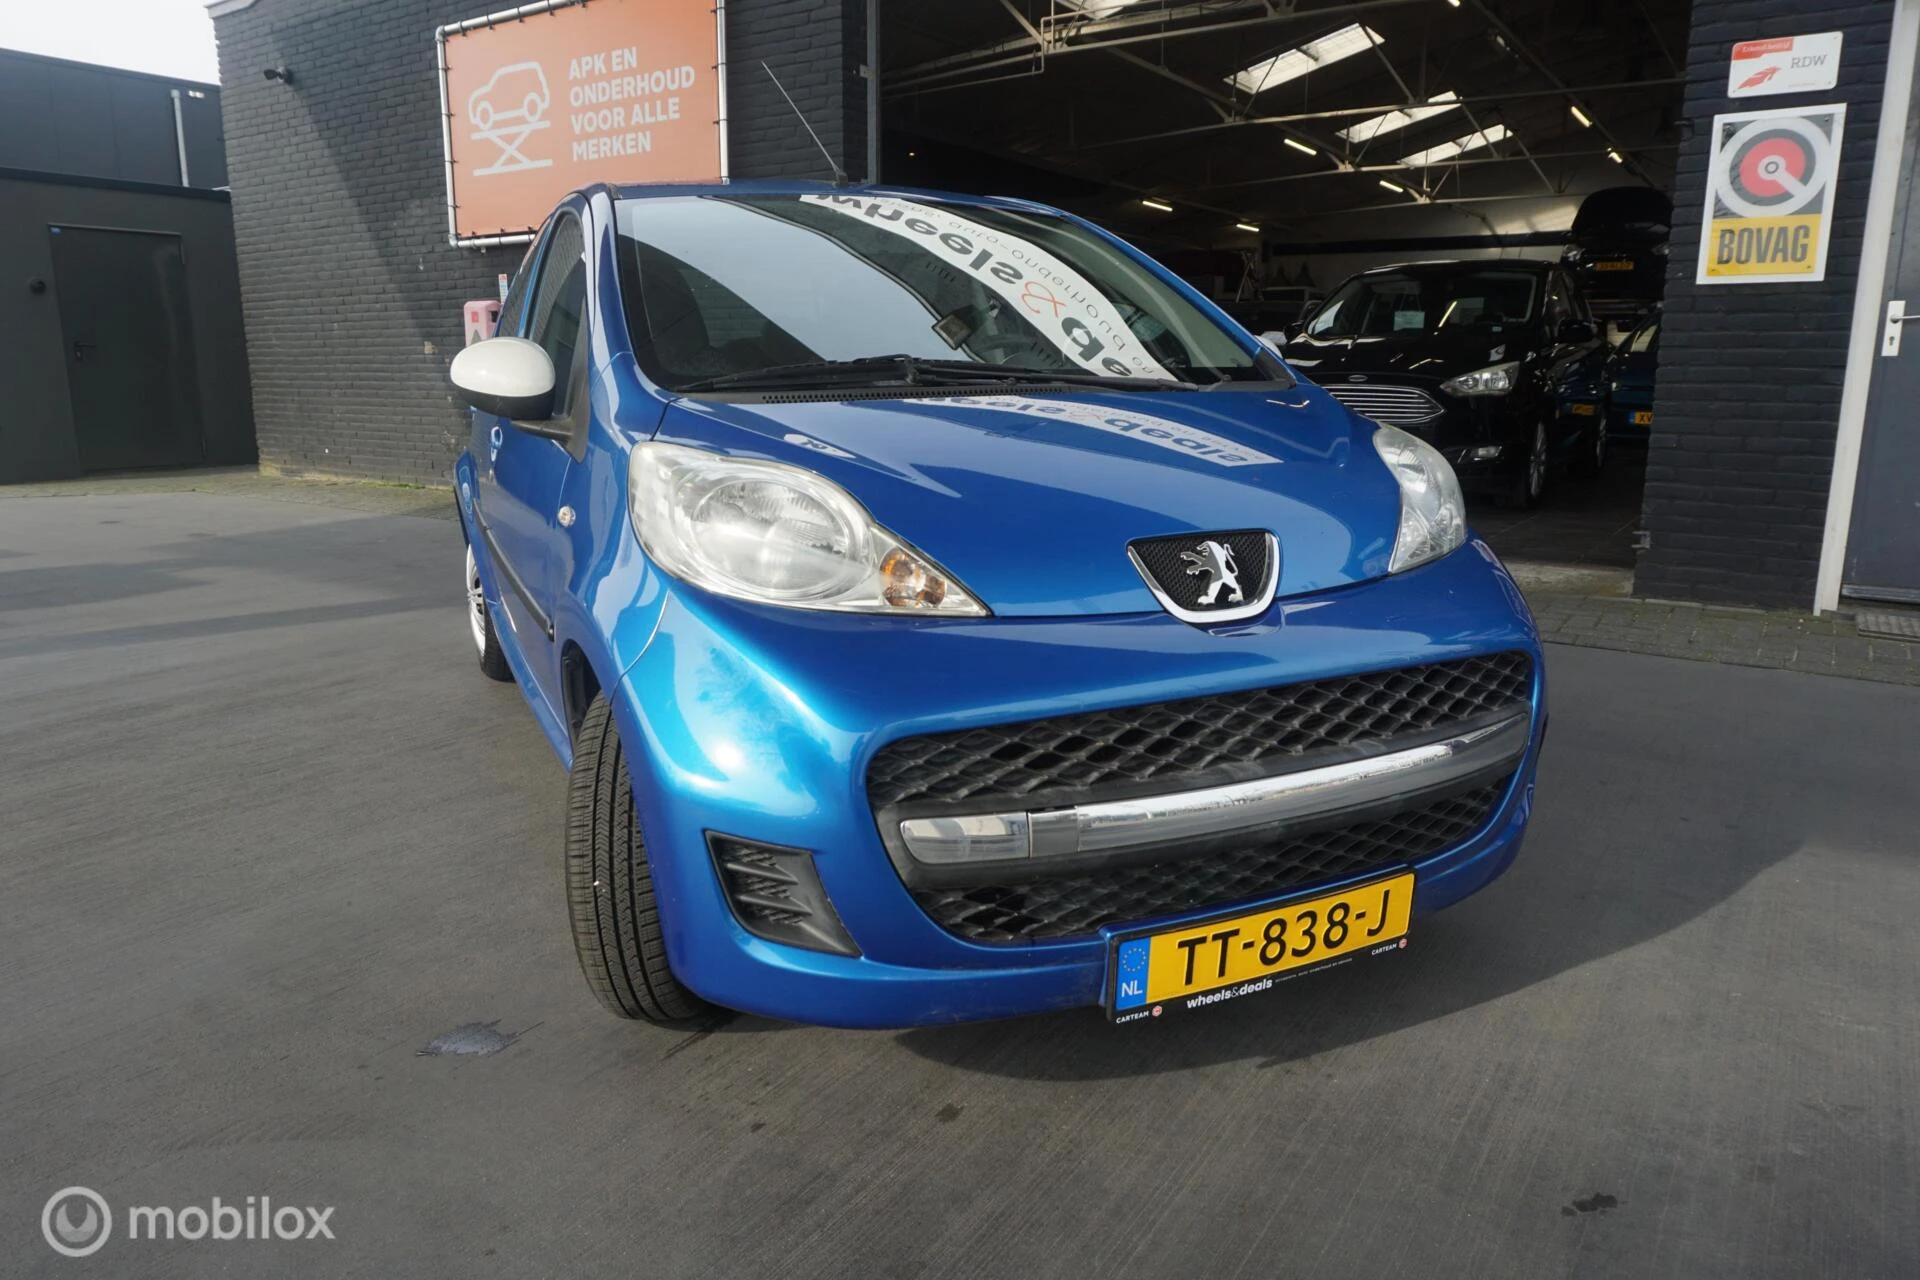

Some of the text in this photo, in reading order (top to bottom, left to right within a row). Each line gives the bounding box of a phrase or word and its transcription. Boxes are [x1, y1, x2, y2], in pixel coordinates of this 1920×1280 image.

[569, 46, 637, 80] APK EN
[1790, 54, 1828, 69] RDW
[570, 65, 695, 106] ONDERHOUD
[571, 97, 680, 135] VOOR ALLE
[572, 131, 652, 162] MERKEN
[1716, 224, 1811, 265] BOVAG
[1177, 889, 1390, 986] TT-838-J
[1371, 943, 1397, 956] CARTEAM
[1121, 979, 1143, 998] NL
[1186, 978, 1273, 1009] wheels&deals
[1115, 1010, 1149, 1024] CARTEAM
